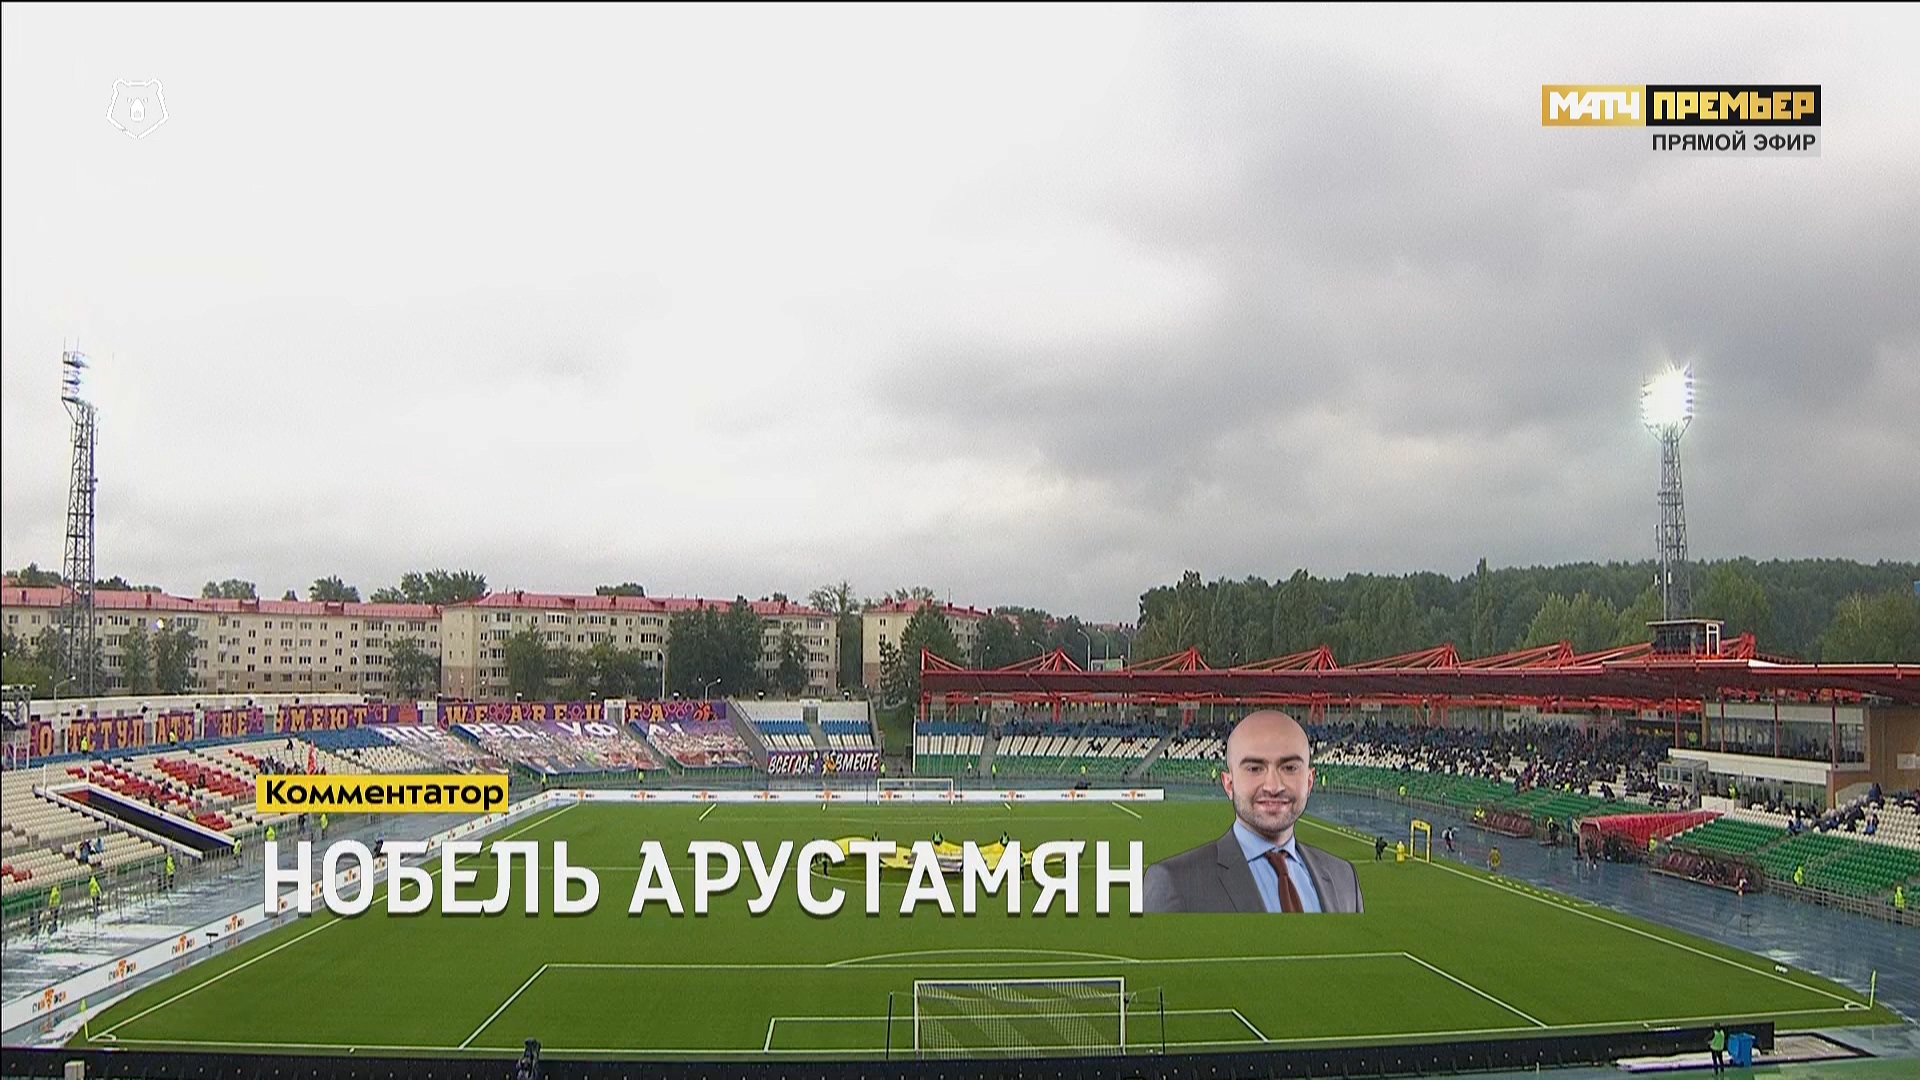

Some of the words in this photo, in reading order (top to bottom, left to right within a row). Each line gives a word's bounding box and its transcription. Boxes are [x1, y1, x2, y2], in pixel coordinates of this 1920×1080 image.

[219, 711, 248, 739] НЕ
[445, 704, 488, 726] WE
[509, 703, 569, 723] ARE
[768, 754, 810, 775] ВСЕГДА
[836, 752, 879, 772] ВМЕСТЕ
